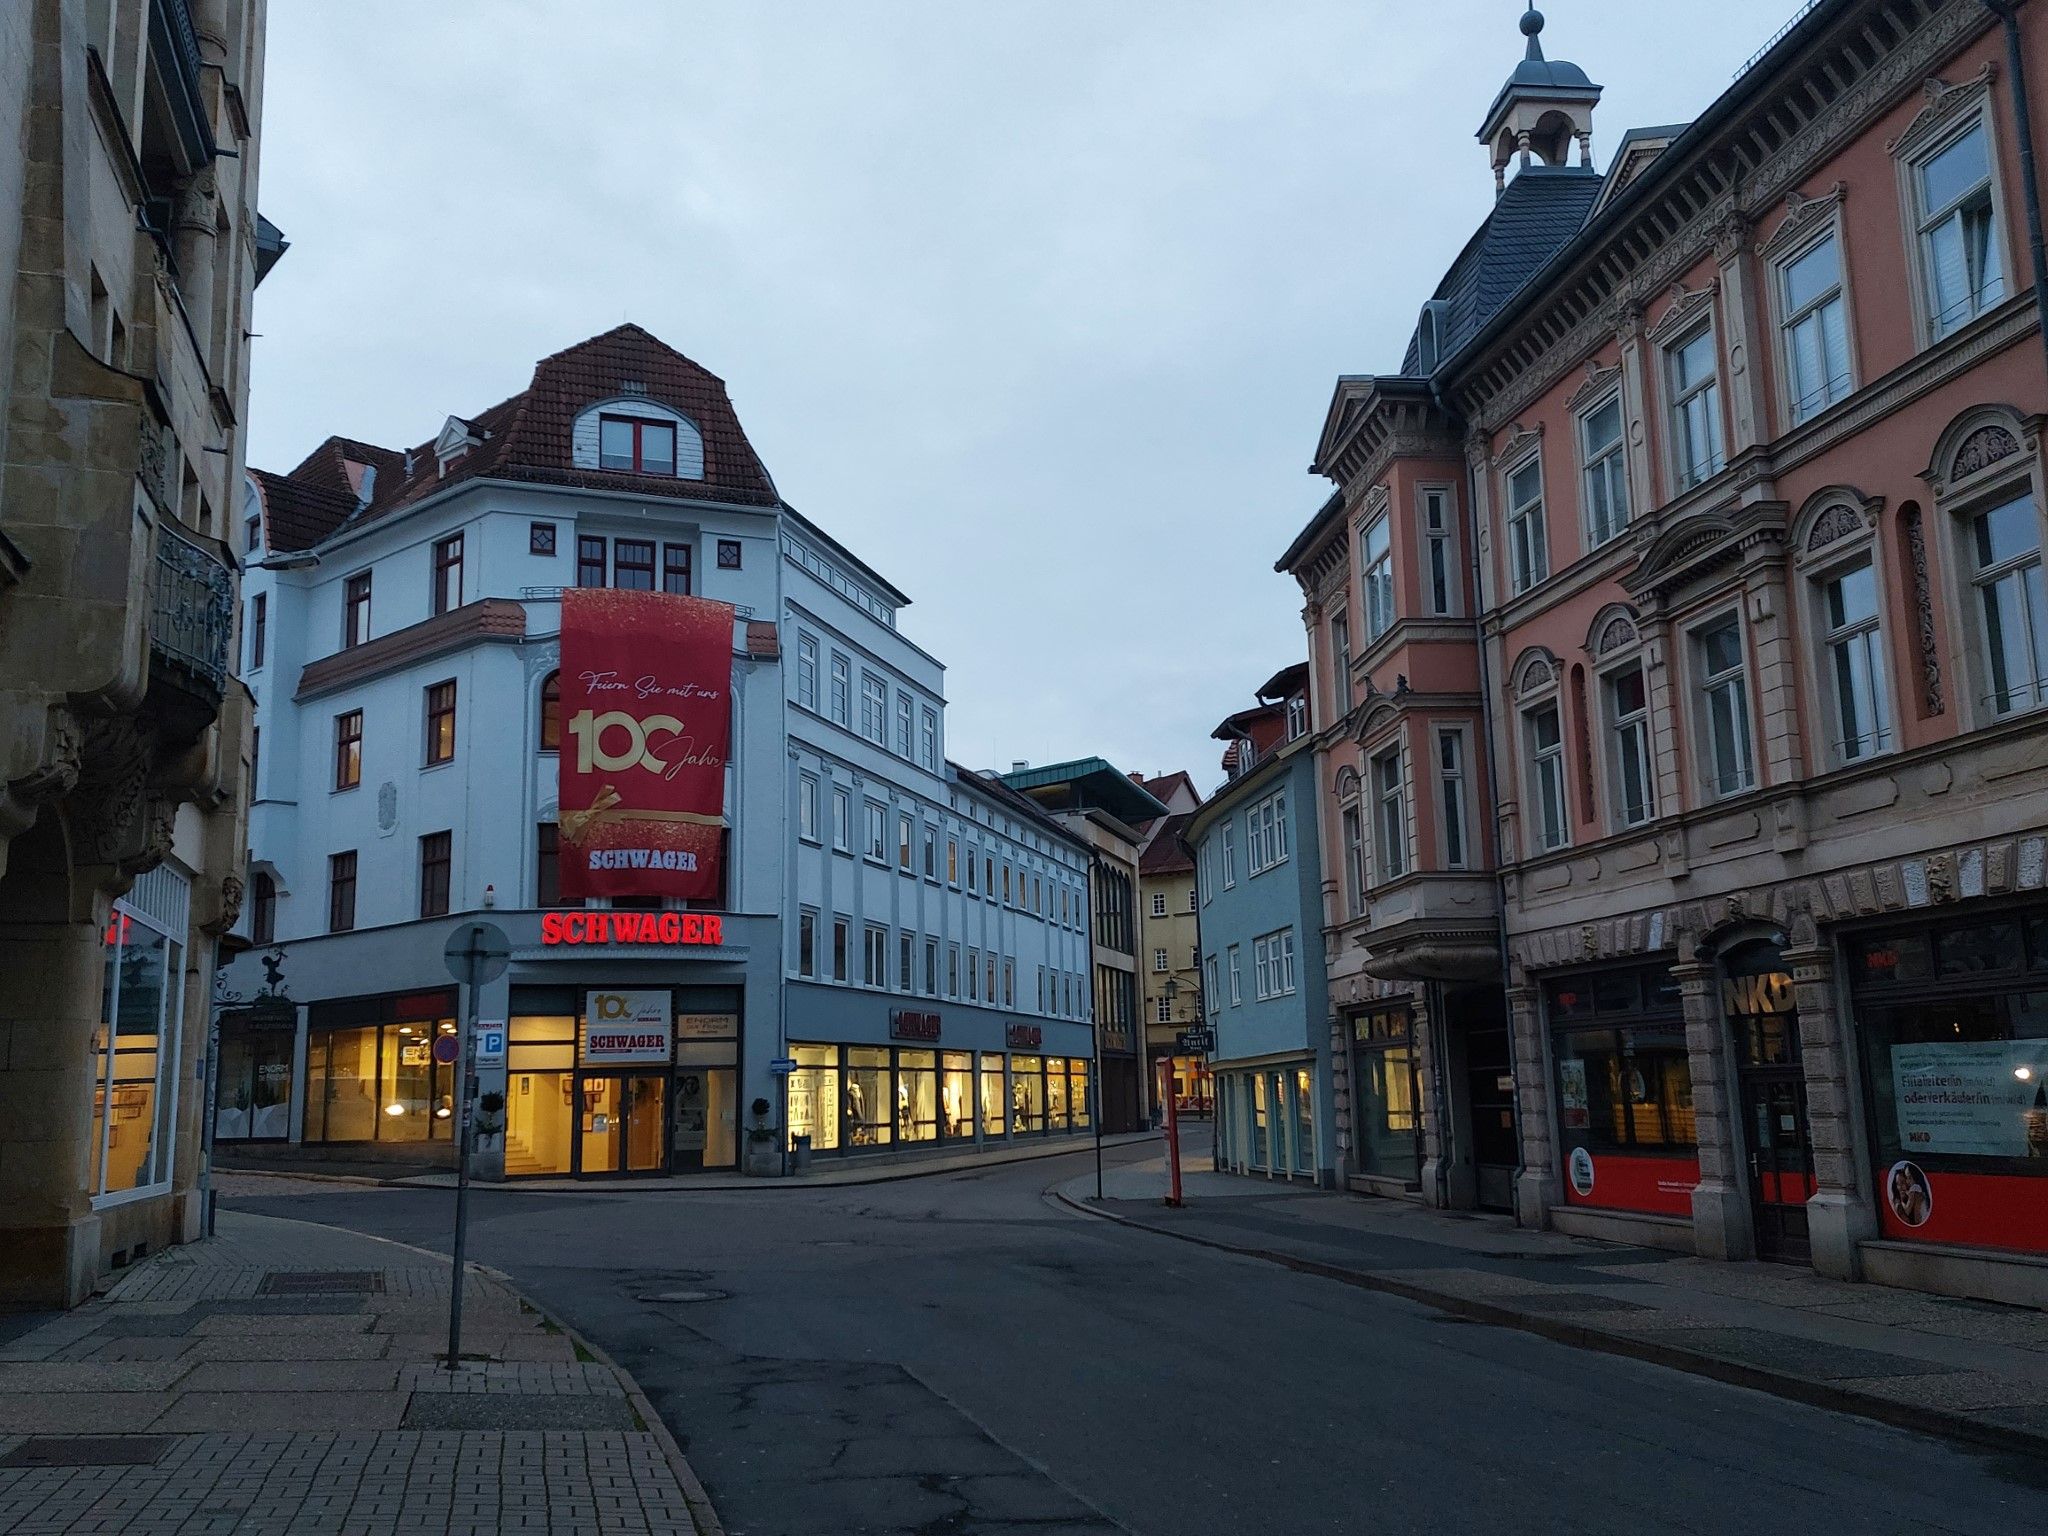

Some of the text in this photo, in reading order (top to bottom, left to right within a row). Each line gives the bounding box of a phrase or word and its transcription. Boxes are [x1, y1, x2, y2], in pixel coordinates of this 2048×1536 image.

[578, 670, 720, 700] Feiern Sie mit uns
[589, 849, 698, 872] SCHWAGER
[541, 912, 725, 946] SCHWAGER
[1724, 971, 1798, 1016] NKD
[488, 1036, 500, 1051] P
[590, 1035, 665, 1049] SCHWAGER
